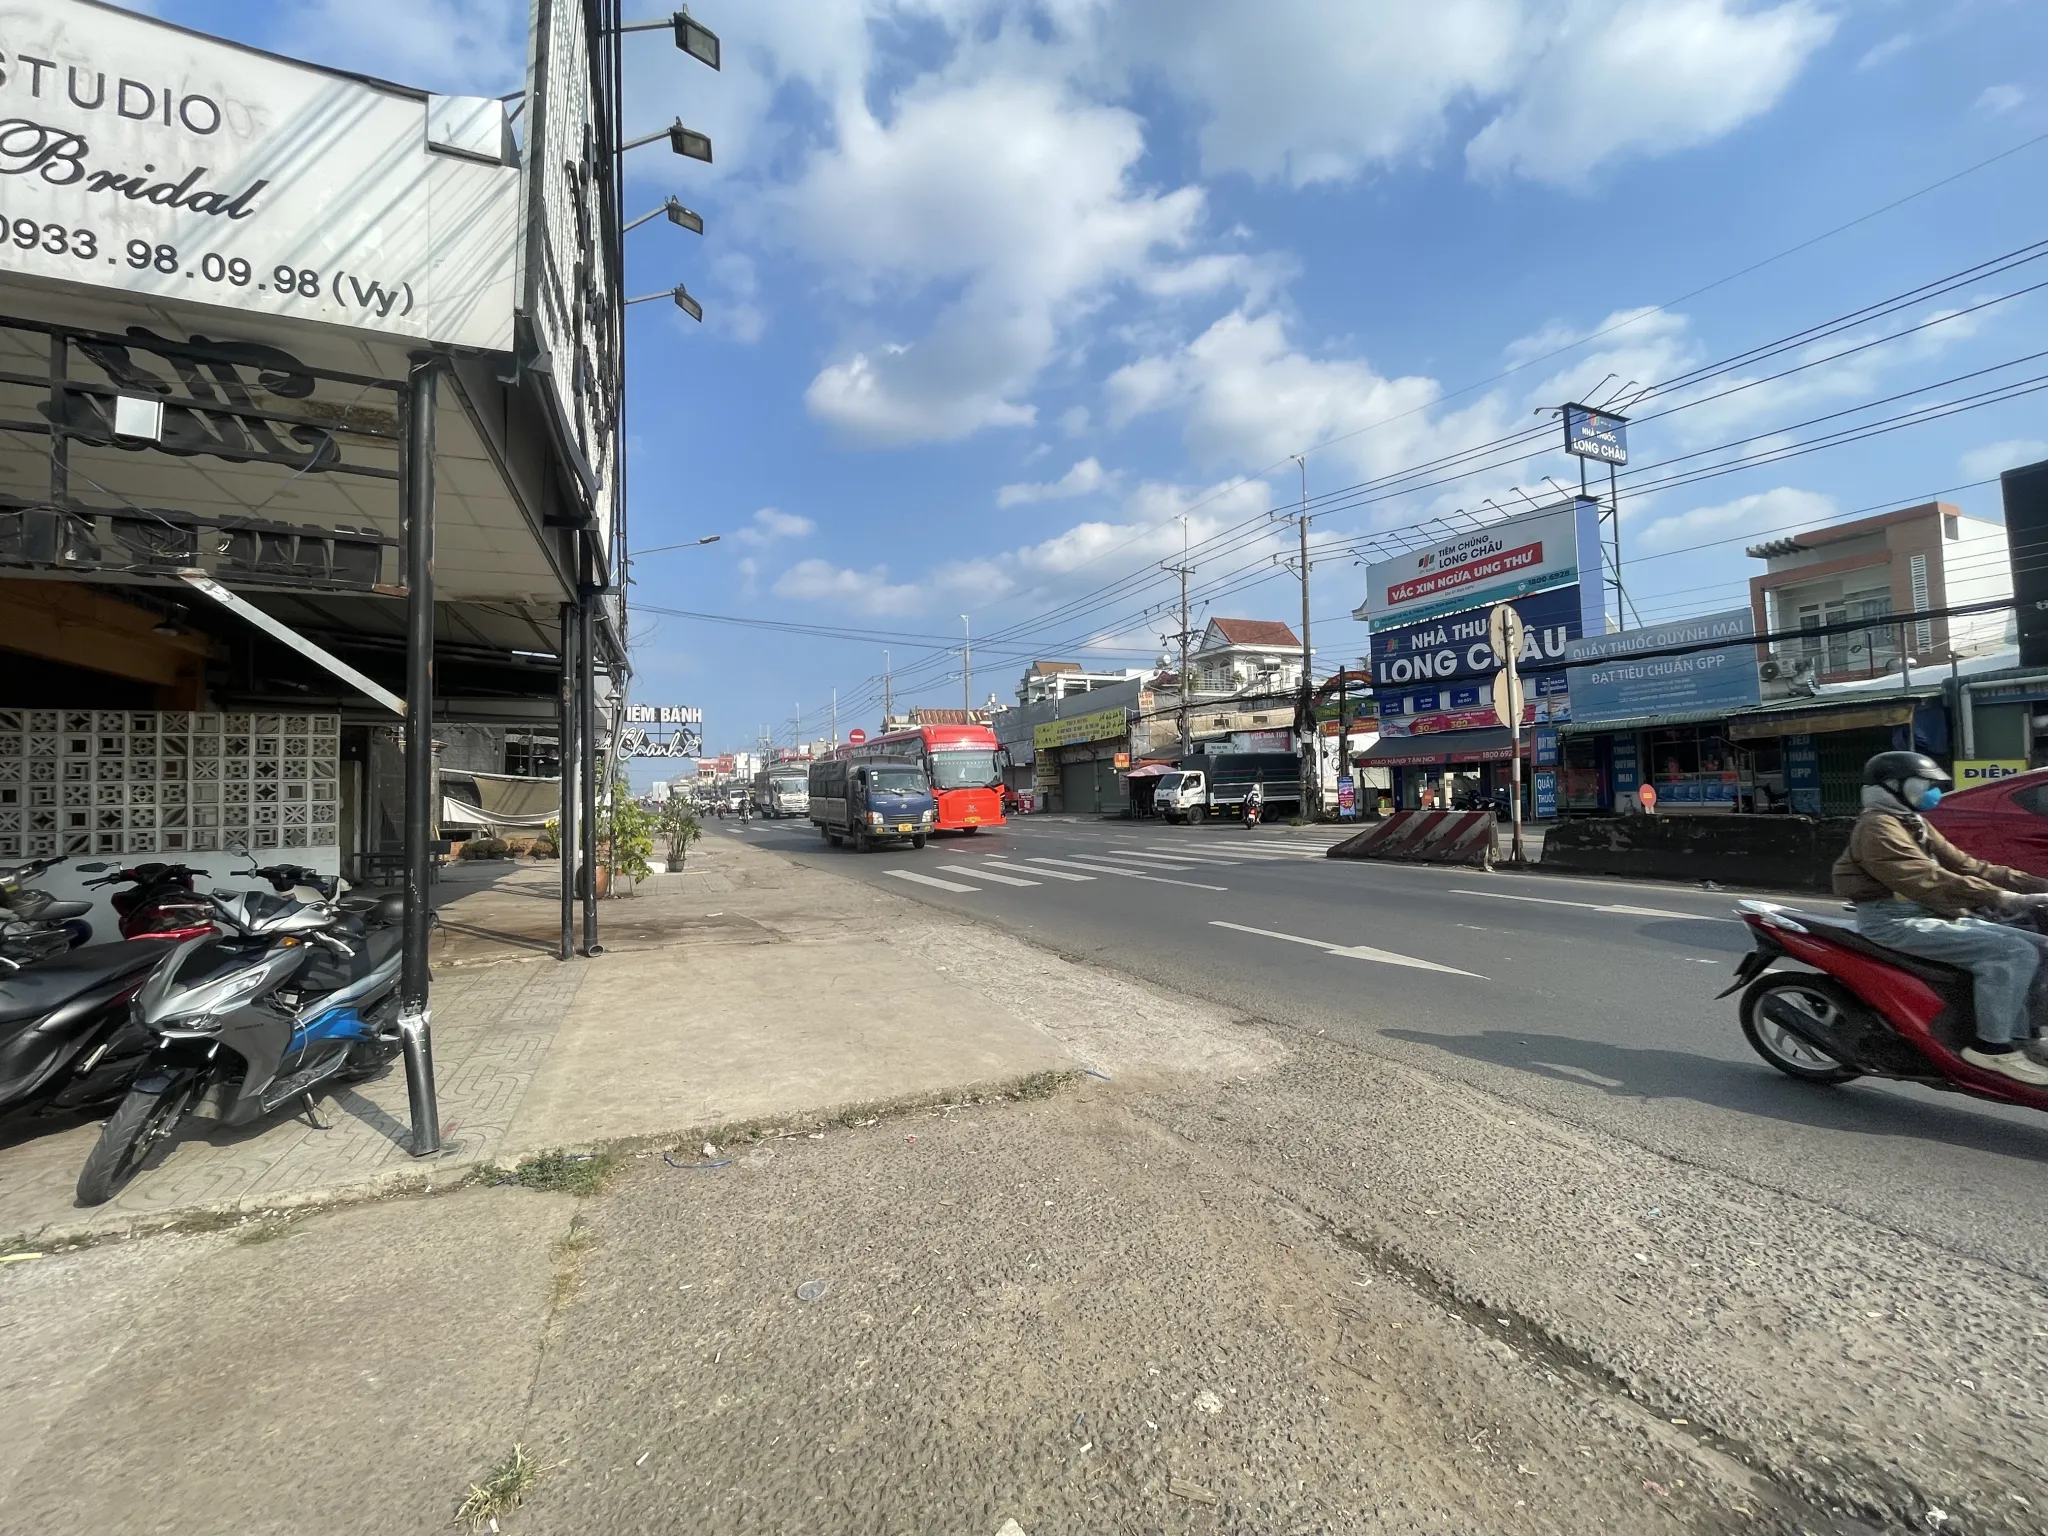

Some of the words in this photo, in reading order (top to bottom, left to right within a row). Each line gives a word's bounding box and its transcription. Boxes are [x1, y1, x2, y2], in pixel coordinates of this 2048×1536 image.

[0, 118, 269, 220] Bridal
[332, 271, 414, 318] (Vy)
[1573, 437, 1599, 454] LONG
[1601, 444, 1626, 461] CHÂU
[1439, 555, 1467, 569] LONG
[1471, 540, 1503, 559] CHÂU
[1458, 535, 1489, 552] CHỦNG
[1391, 585, 1414, 601] VẮC
[1416, 580, 1435, 592] XIN
[1437, 570, 1471, 587] NGỪA
[1474, 561, 1501, 577] UNG
[1503, 550, 1534, 569] THƯ
[1411, 625, 1448, 650] NHÀ
[1452, 618, 1489, 641] THU
[1611, 634, 1654, 653] THUỐC
[1712, 619, 1744, 637] MAI
[1380, 650, 1457, 684] LONG
[1467, 624, 1567, 670] CÂU
[1591, 672, 1615, 685] ĐẠT
[1617, 664, 1644, 681] TIÊU
[1647, 655, 1693, 677] CHUẨN
[1696, 654, 1726, 670] GPP
[627, 704, 655, 725] IỆM
[660, 704, 702, 723] BÁNH
[1791, 768, 1811, 778] GPP
